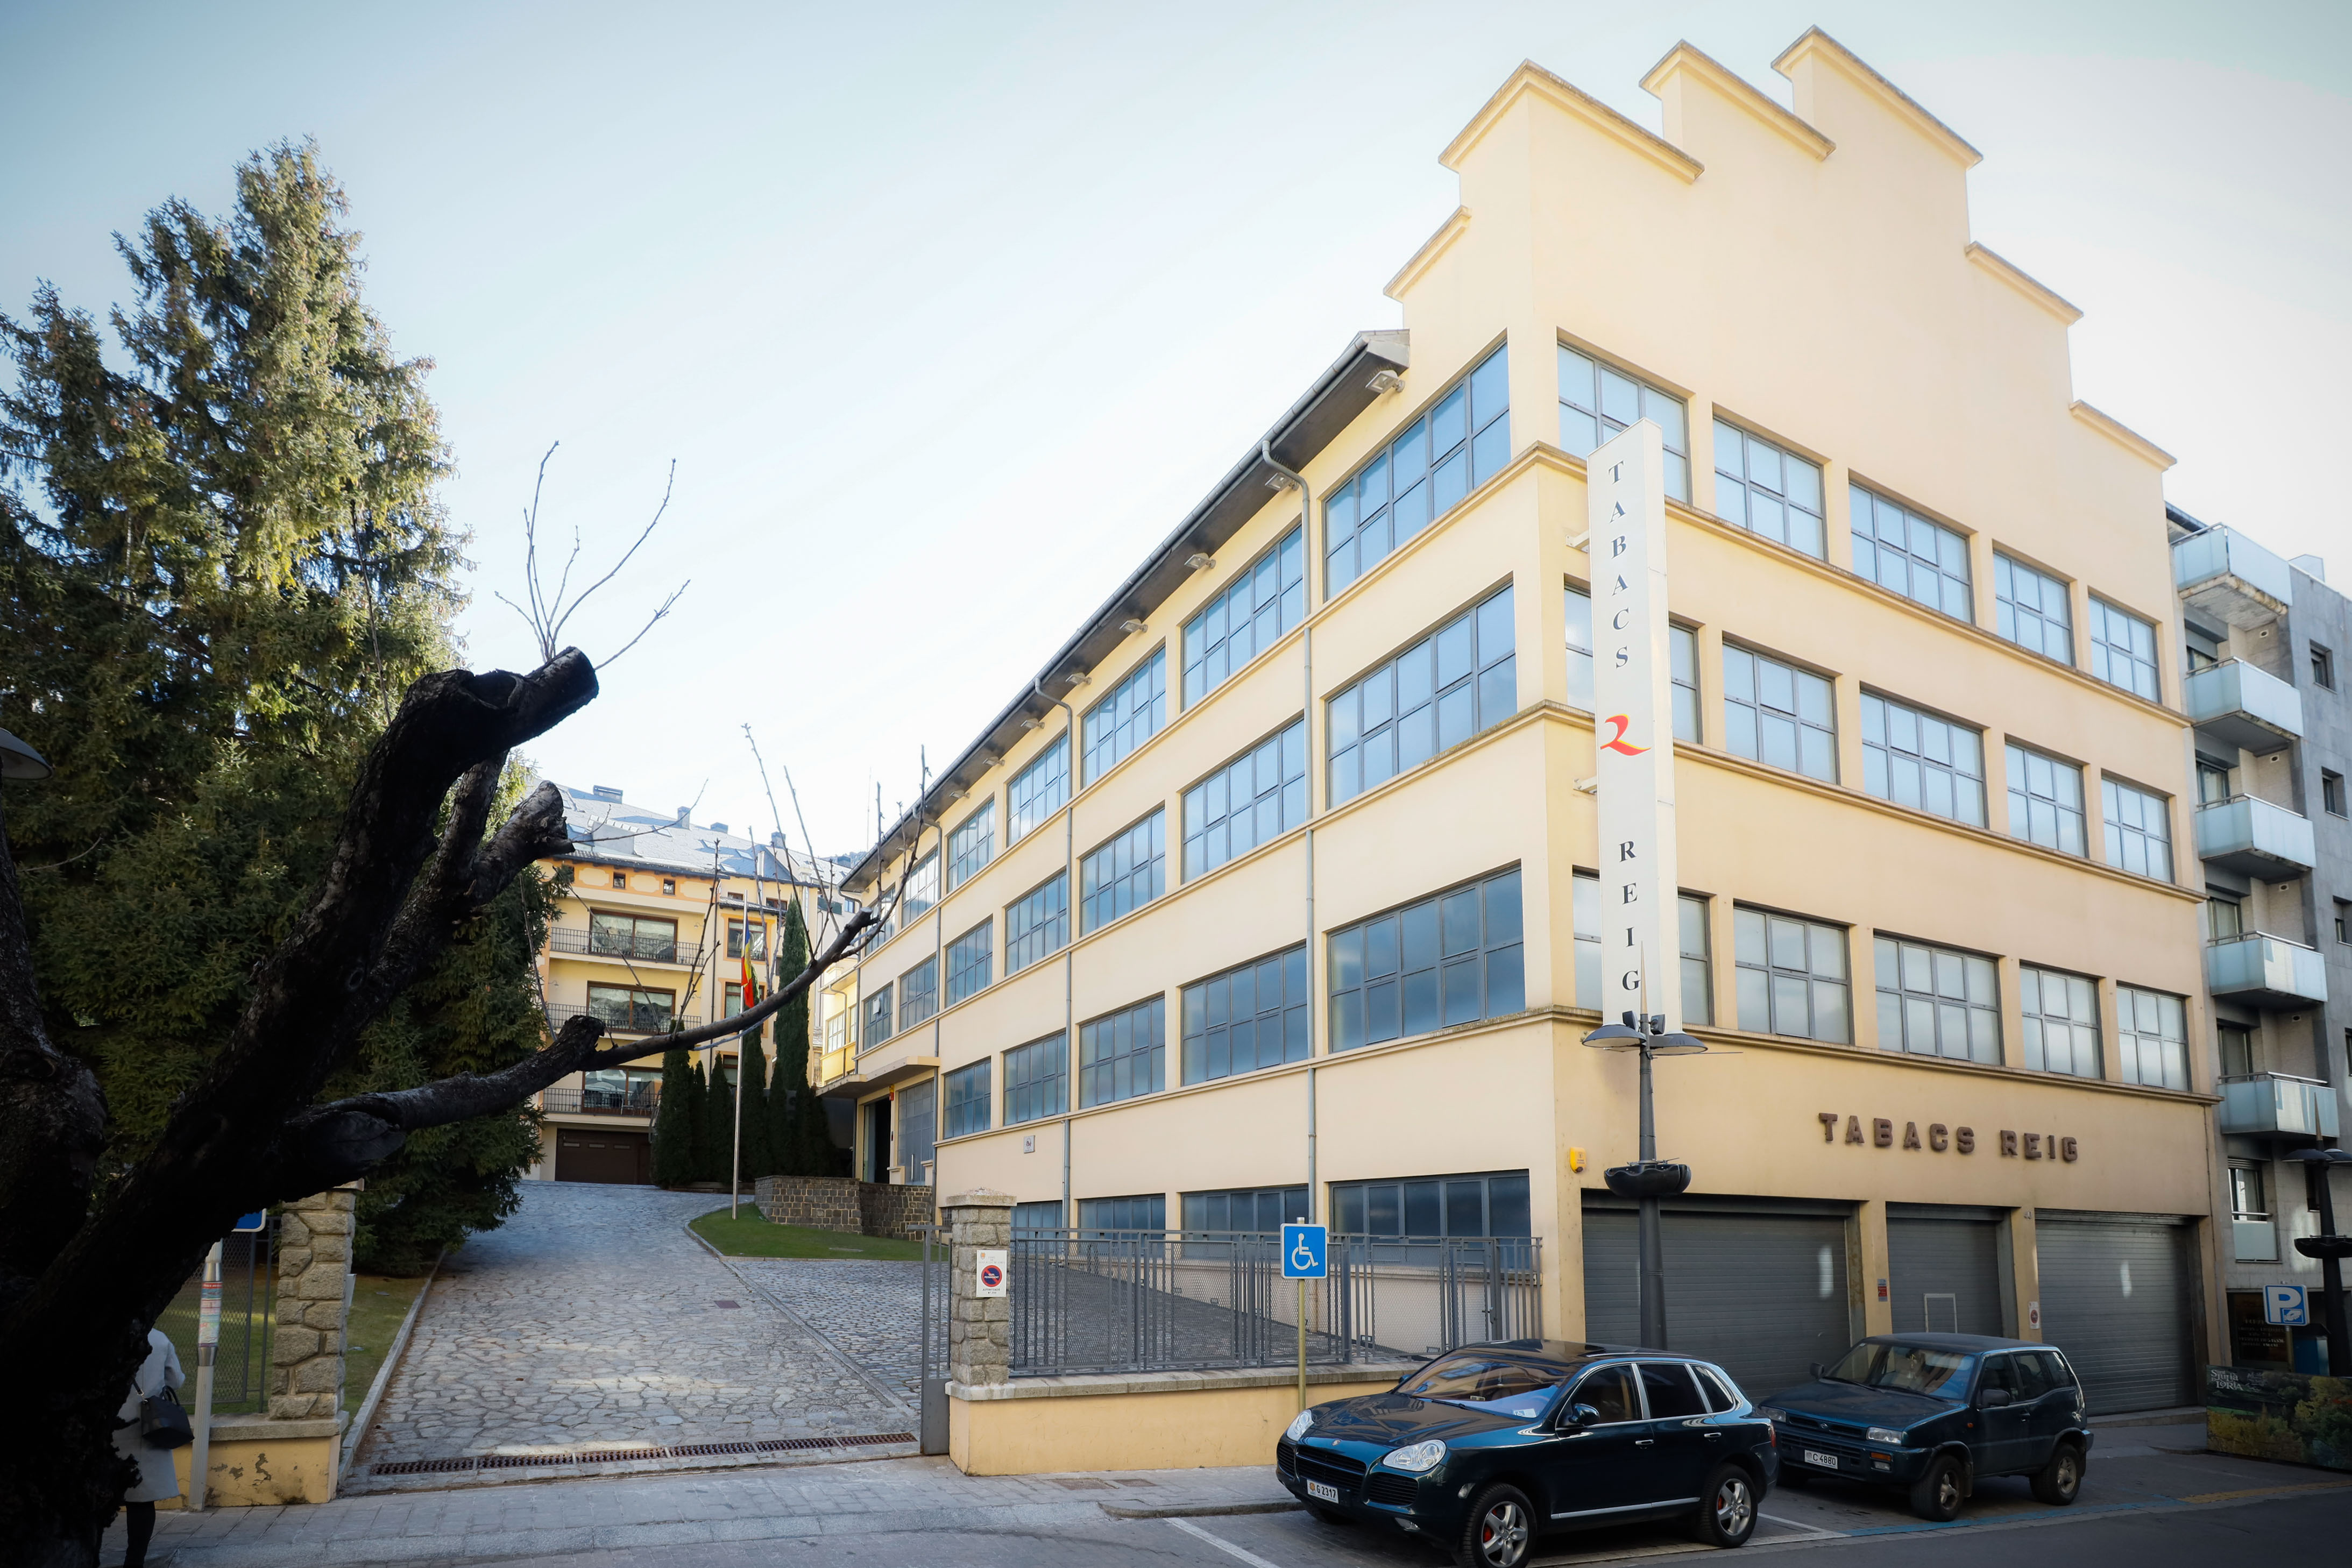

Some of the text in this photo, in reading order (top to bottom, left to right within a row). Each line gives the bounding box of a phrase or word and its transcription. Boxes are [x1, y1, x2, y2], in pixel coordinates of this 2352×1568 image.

[1608, 460, 1628, 670] TABACS
[1619, 840, 1641, 991] REIG
[1818, 1112, 2078, 1161] TABACS REIG
[2267, 1286, 2301, 1323] P
[1813, 1453, 1818, 1461] C
[1819, 1455, 1836, 1465] 4880
[1316, 1485, 1320, 1494] G
[1322, 1486, 1336, 1498] 2317
